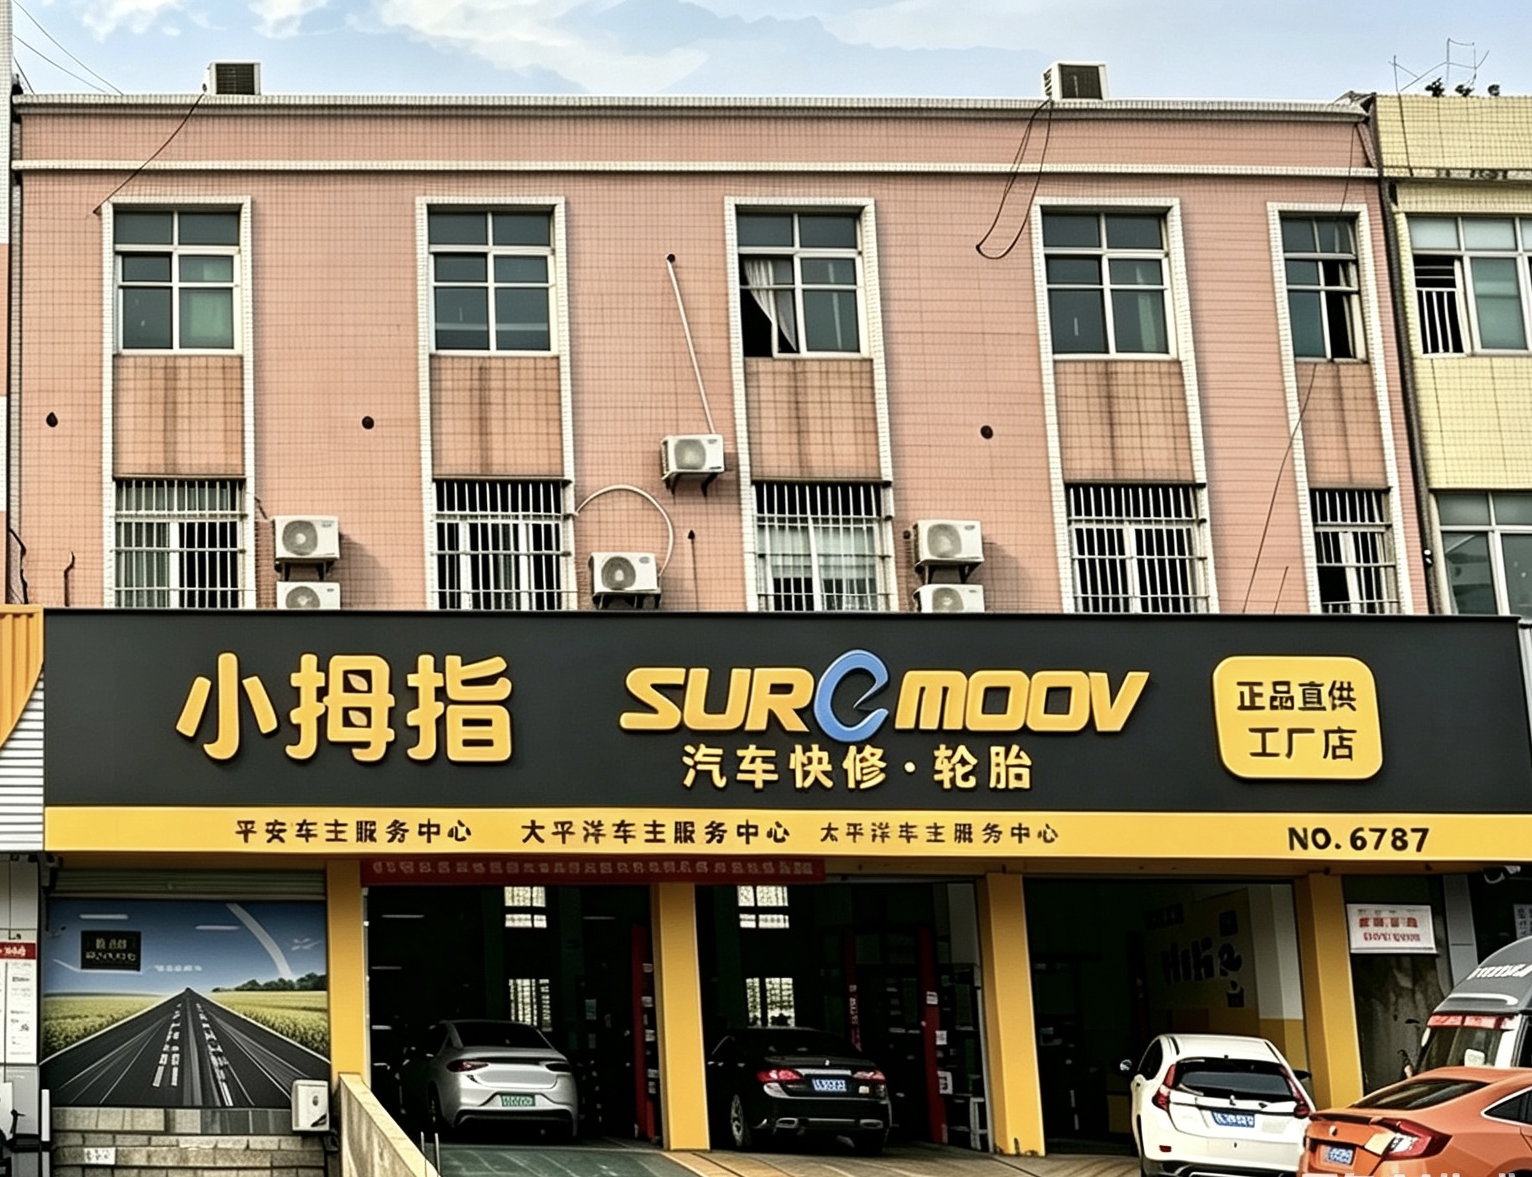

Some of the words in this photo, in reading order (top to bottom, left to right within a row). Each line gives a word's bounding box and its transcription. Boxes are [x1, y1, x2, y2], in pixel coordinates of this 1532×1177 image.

[175, 651, 514, 763] 小拇指
[1236, 680, 1357, 711] 正品直供
[1248, 726, 1357, 761] 工厂店
[235, 819, 472, 844] 平安车主服务中心
